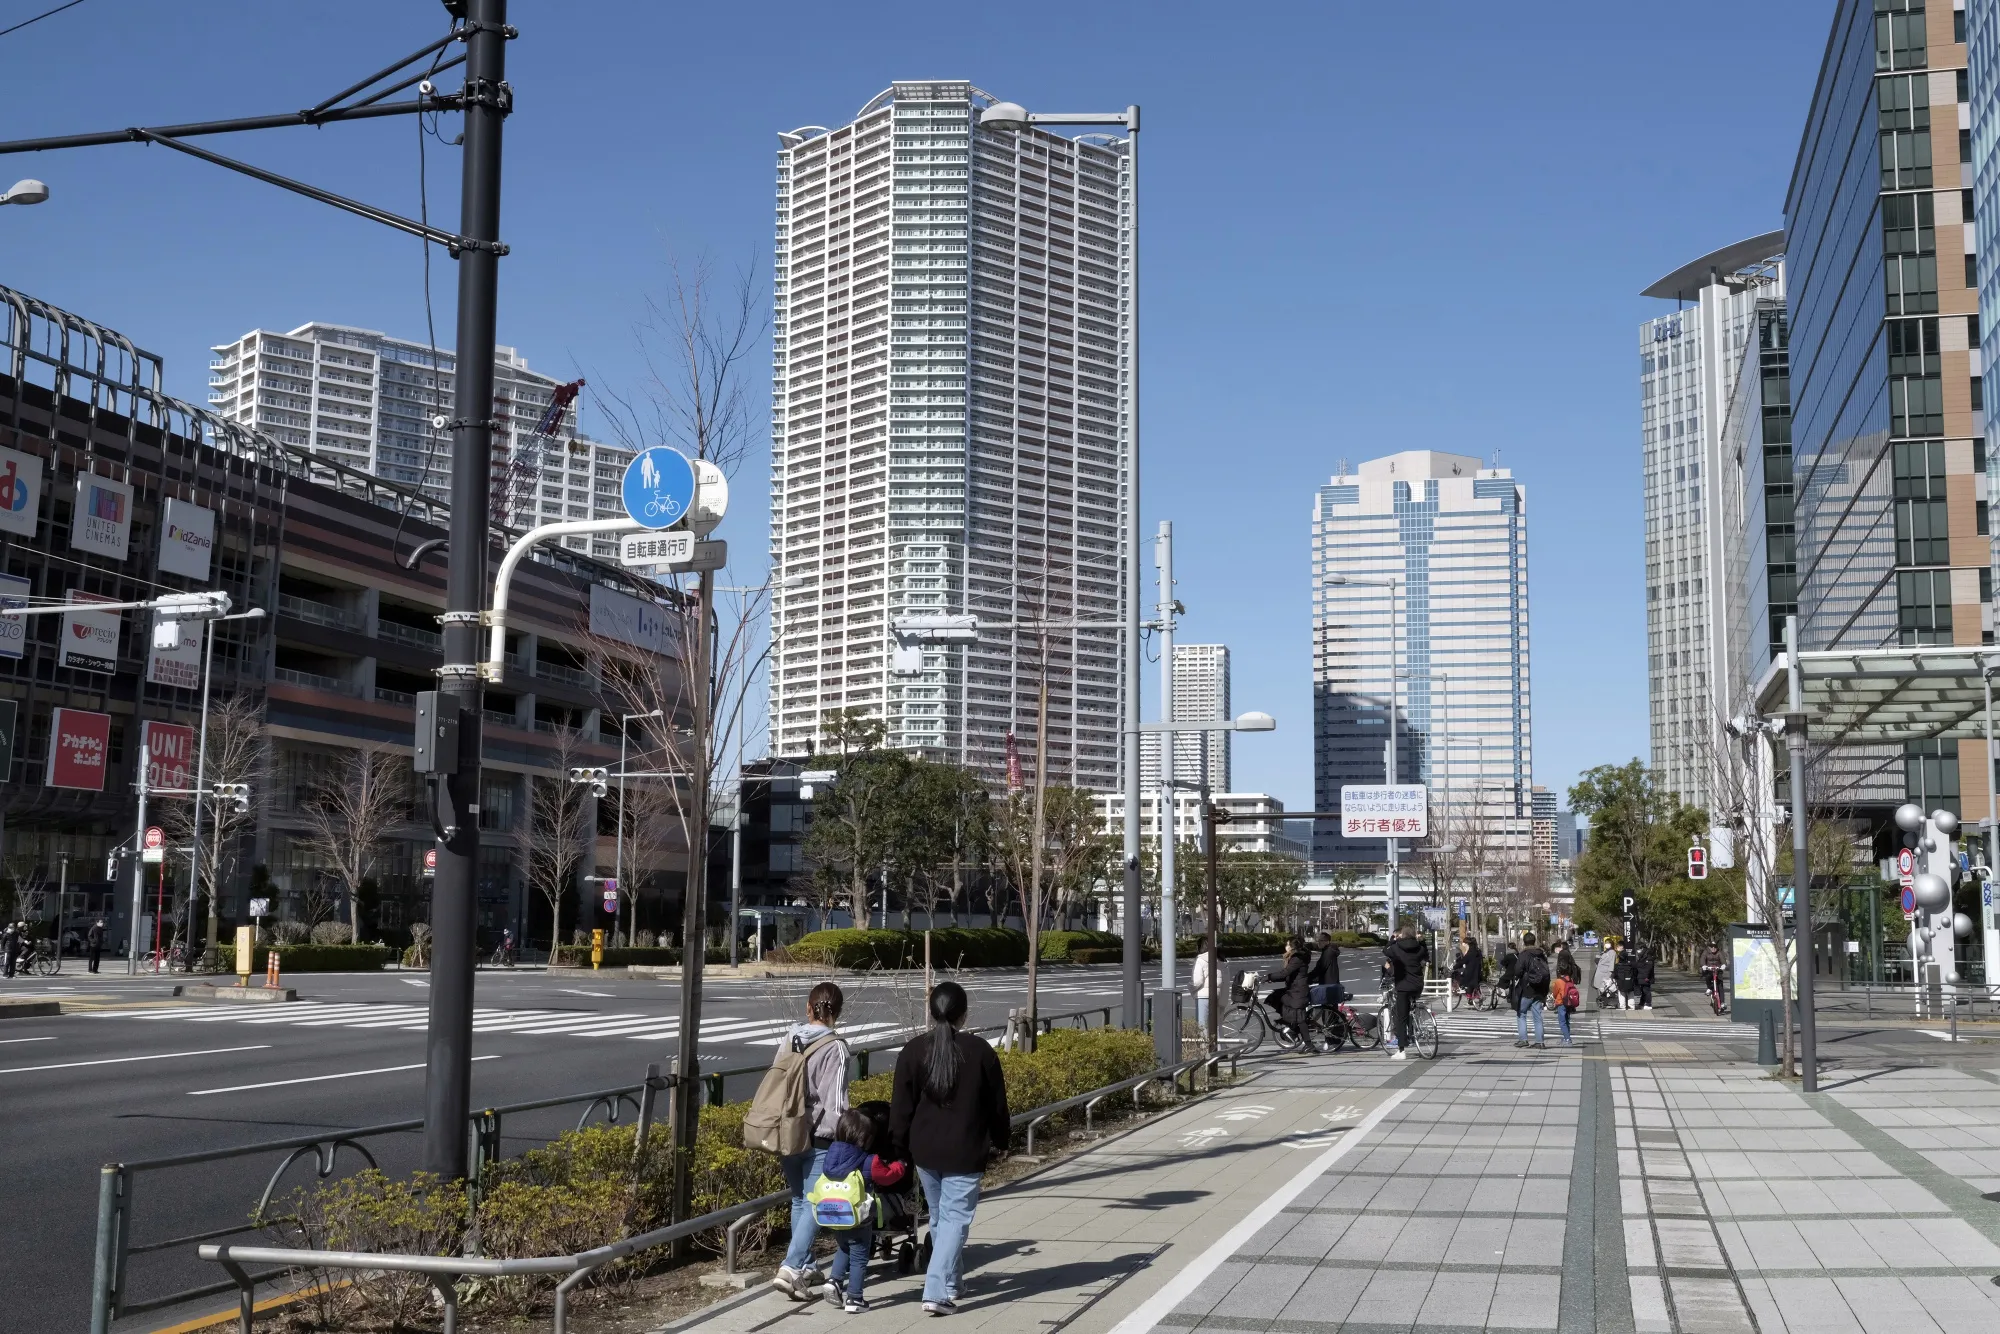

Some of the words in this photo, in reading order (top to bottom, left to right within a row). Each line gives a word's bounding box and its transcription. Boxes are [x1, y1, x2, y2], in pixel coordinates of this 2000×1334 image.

[1653, 317, 1683, 342] IHI
[86, 517, 116, 534] UNITED
[85, 528, 121, 548] CINEMAS
[168, 524, 211, 549] KidZania
[627, 538, 688, 559] 自転車通行可
[62, 733, 103, 751] アカチャン
[1344, 790, 1424, 801] 自転車は歩行者の迷惑に
[1344, 802, 1424, 813] ならないように走りましょう
[1347, 818, 1421, 833] 歩行者優先
[1901, 856, 1910, 868] 40
[1983, 882, 1992, 907] SCSK
[1623, 896, 1634, 913] P
